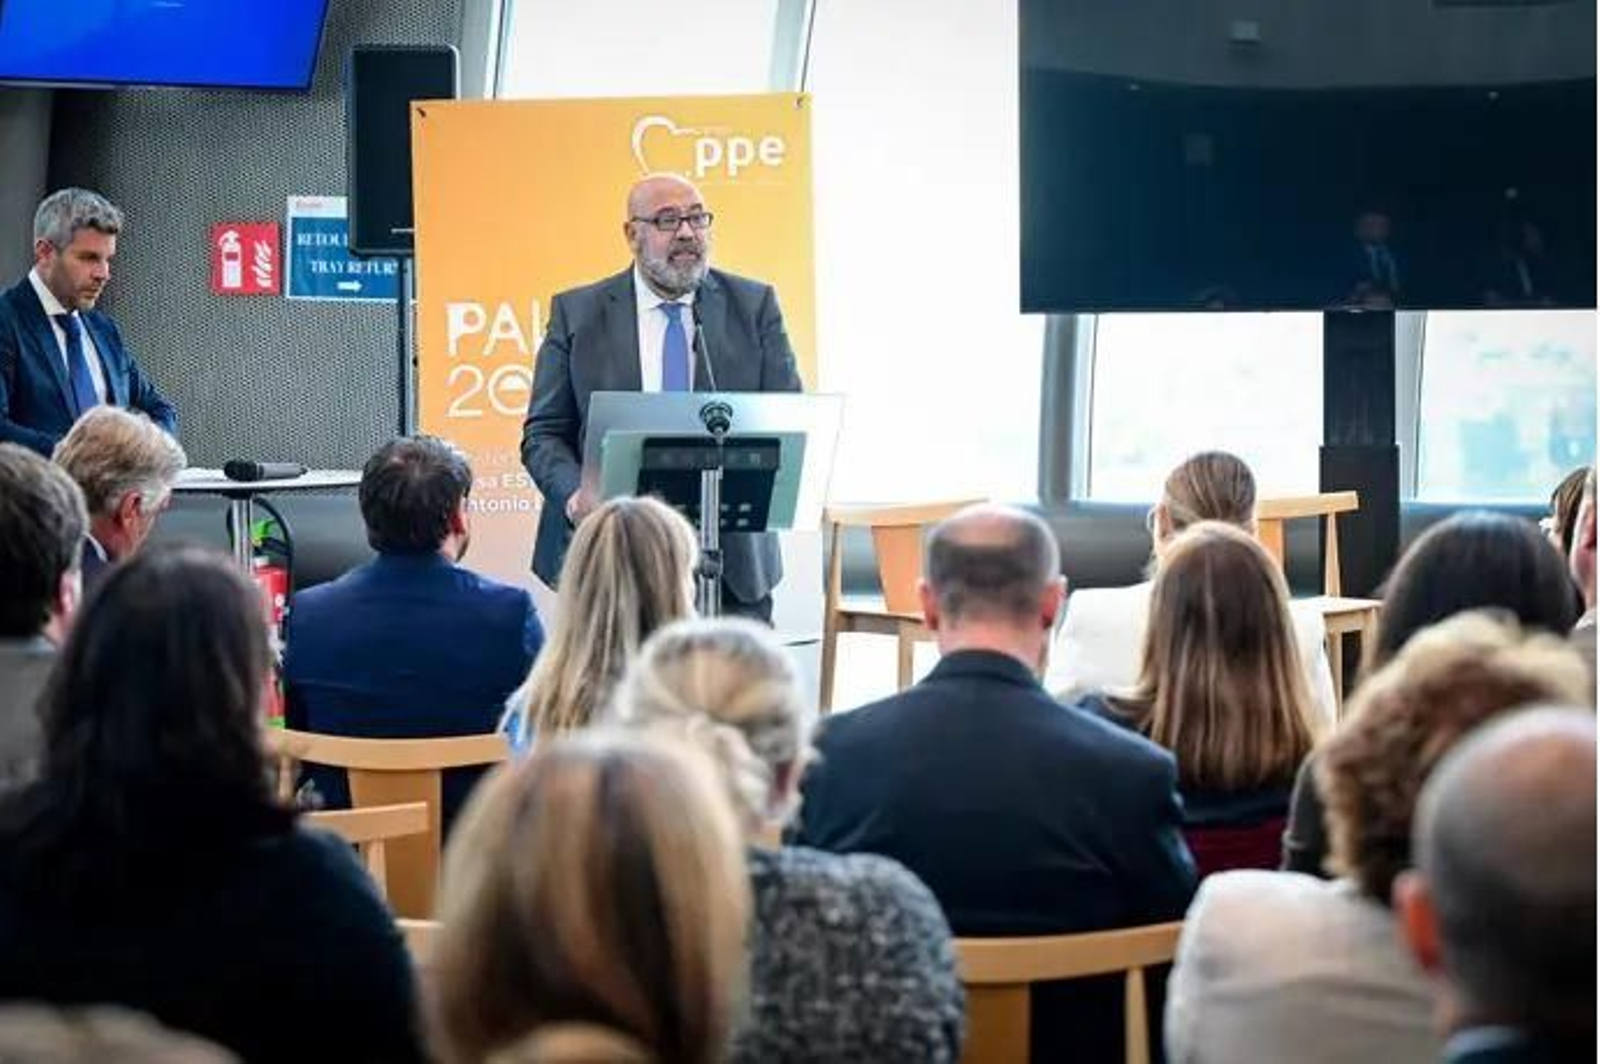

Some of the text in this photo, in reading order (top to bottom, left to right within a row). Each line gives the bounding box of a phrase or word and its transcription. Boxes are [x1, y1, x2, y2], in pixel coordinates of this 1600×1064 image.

[695, 135, 785, 178] ppe
[310, 260, 345, 273] TRAY
[466, 495, 529, 511] ntonio
